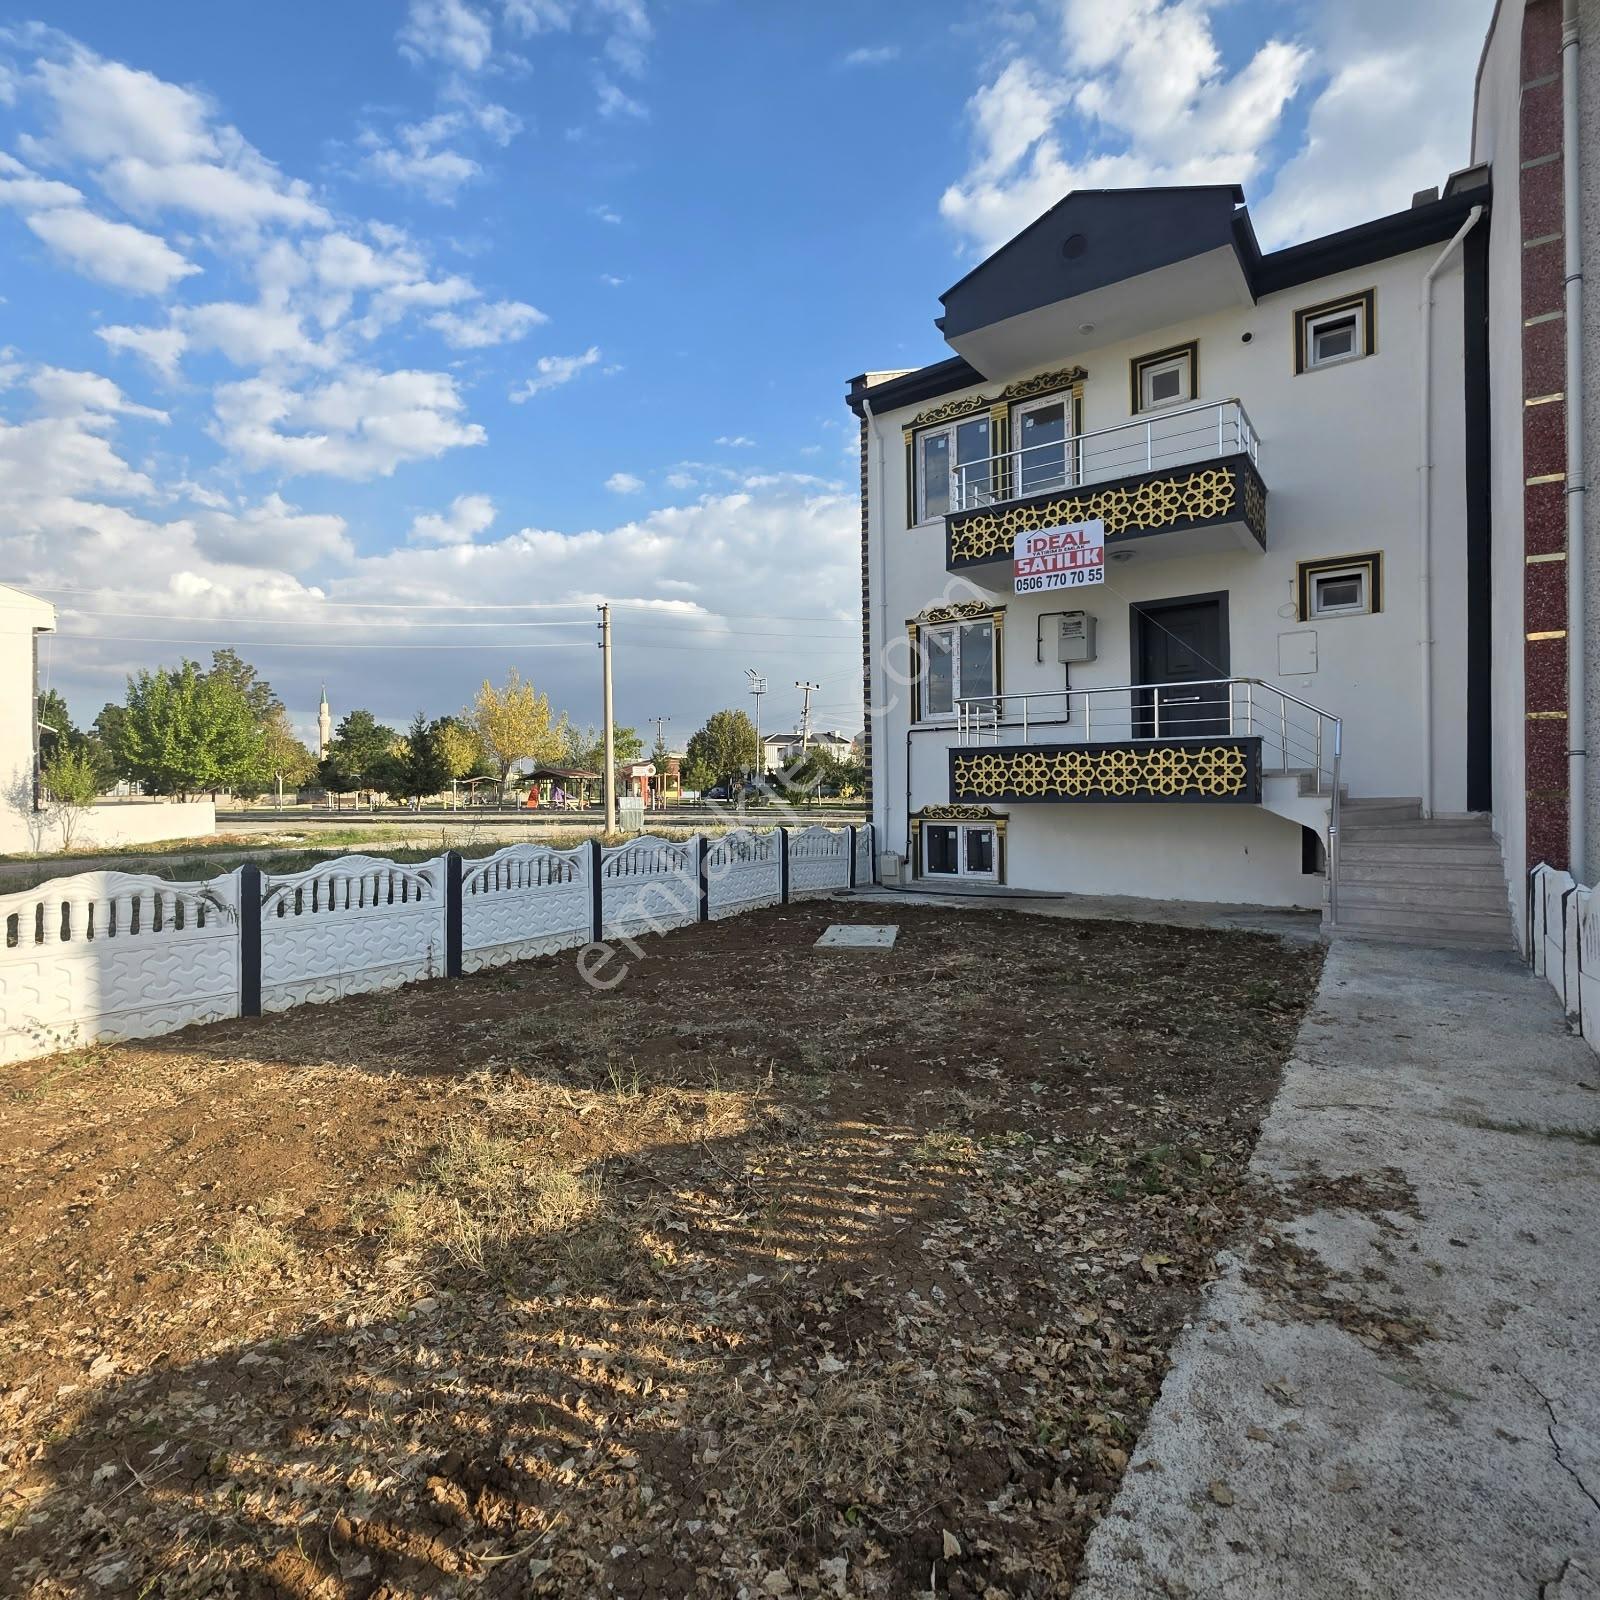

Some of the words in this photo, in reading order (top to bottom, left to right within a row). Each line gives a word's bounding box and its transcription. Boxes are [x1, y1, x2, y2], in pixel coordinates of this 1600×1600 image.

[1018, 548, 1100, 574] SATILIK
[1016, 577, 1042, 591] 0506
[1046, 573, 1067, 587] 770
[1070, 570, 1085, 584] 70
[1088, 568, 1103, 582] 55
